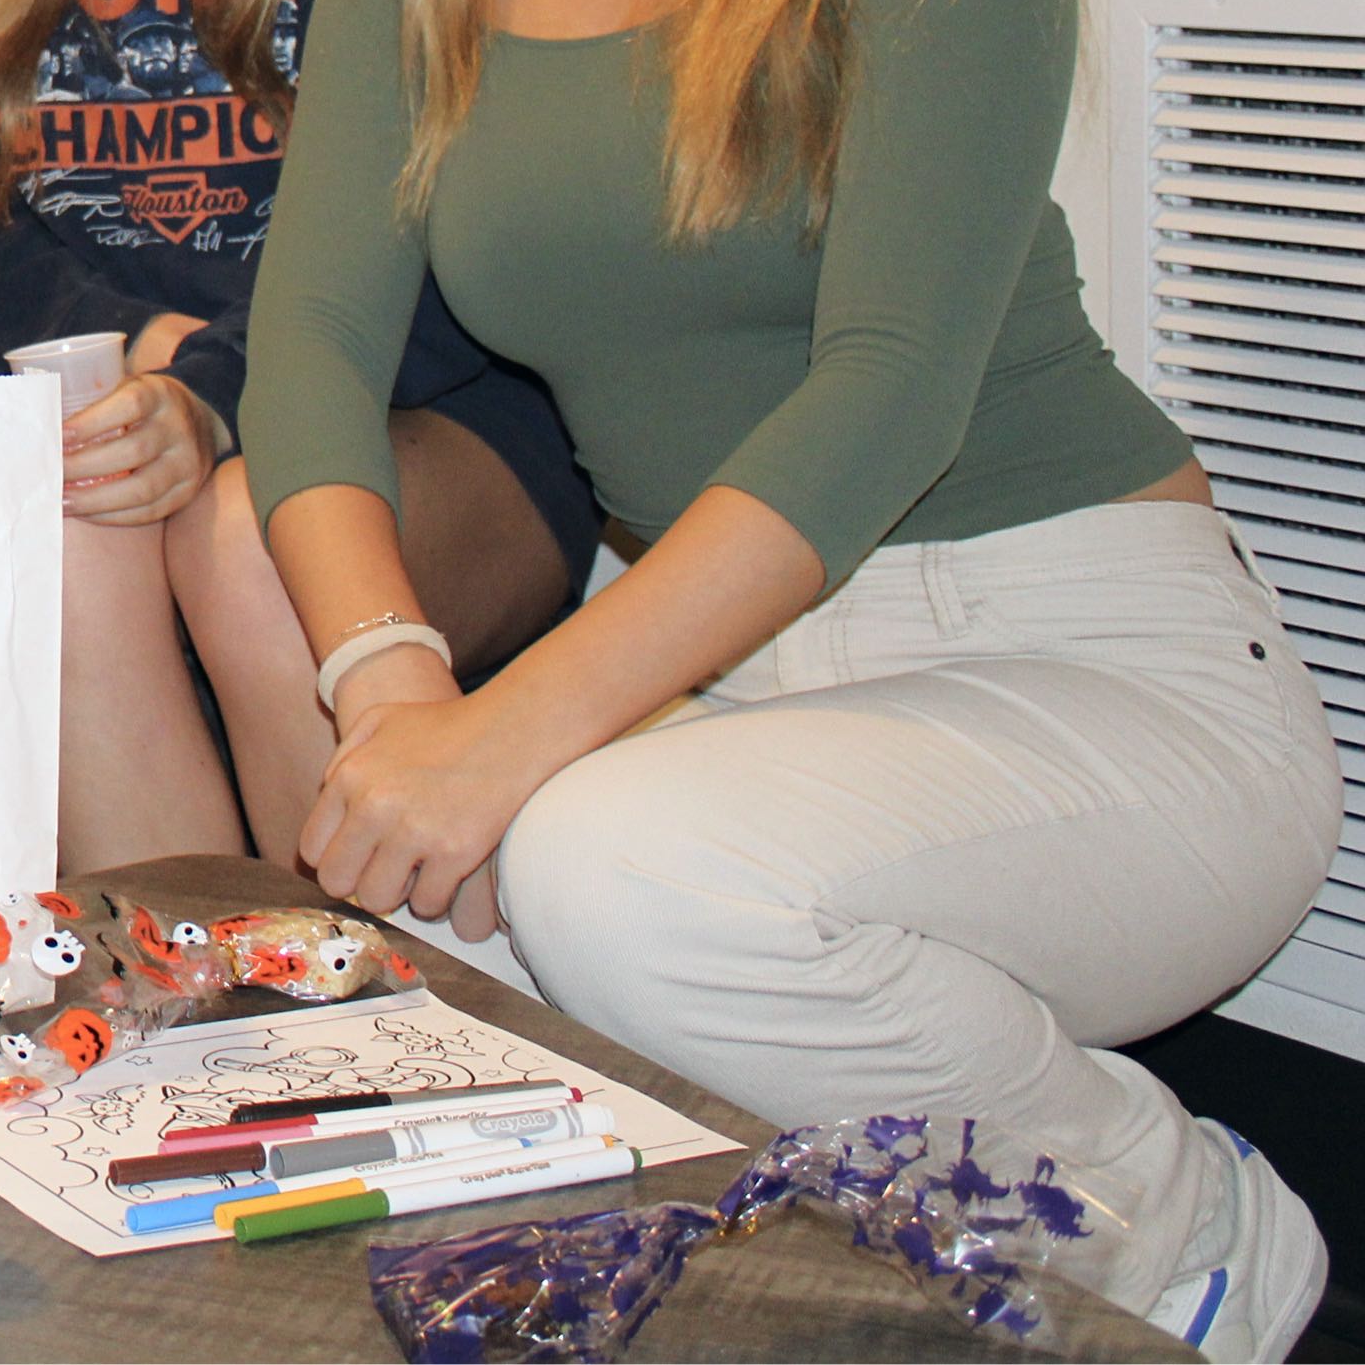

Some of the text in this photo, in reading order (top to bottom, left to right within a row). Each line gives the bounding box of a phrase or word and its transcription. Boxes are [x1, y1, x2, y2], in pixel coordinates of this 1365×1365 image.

[14, 101, 279, 165] HAMPIO
[124, 186, 243, 217] Houston
[477, 1110, 550, 1133] Crayola
